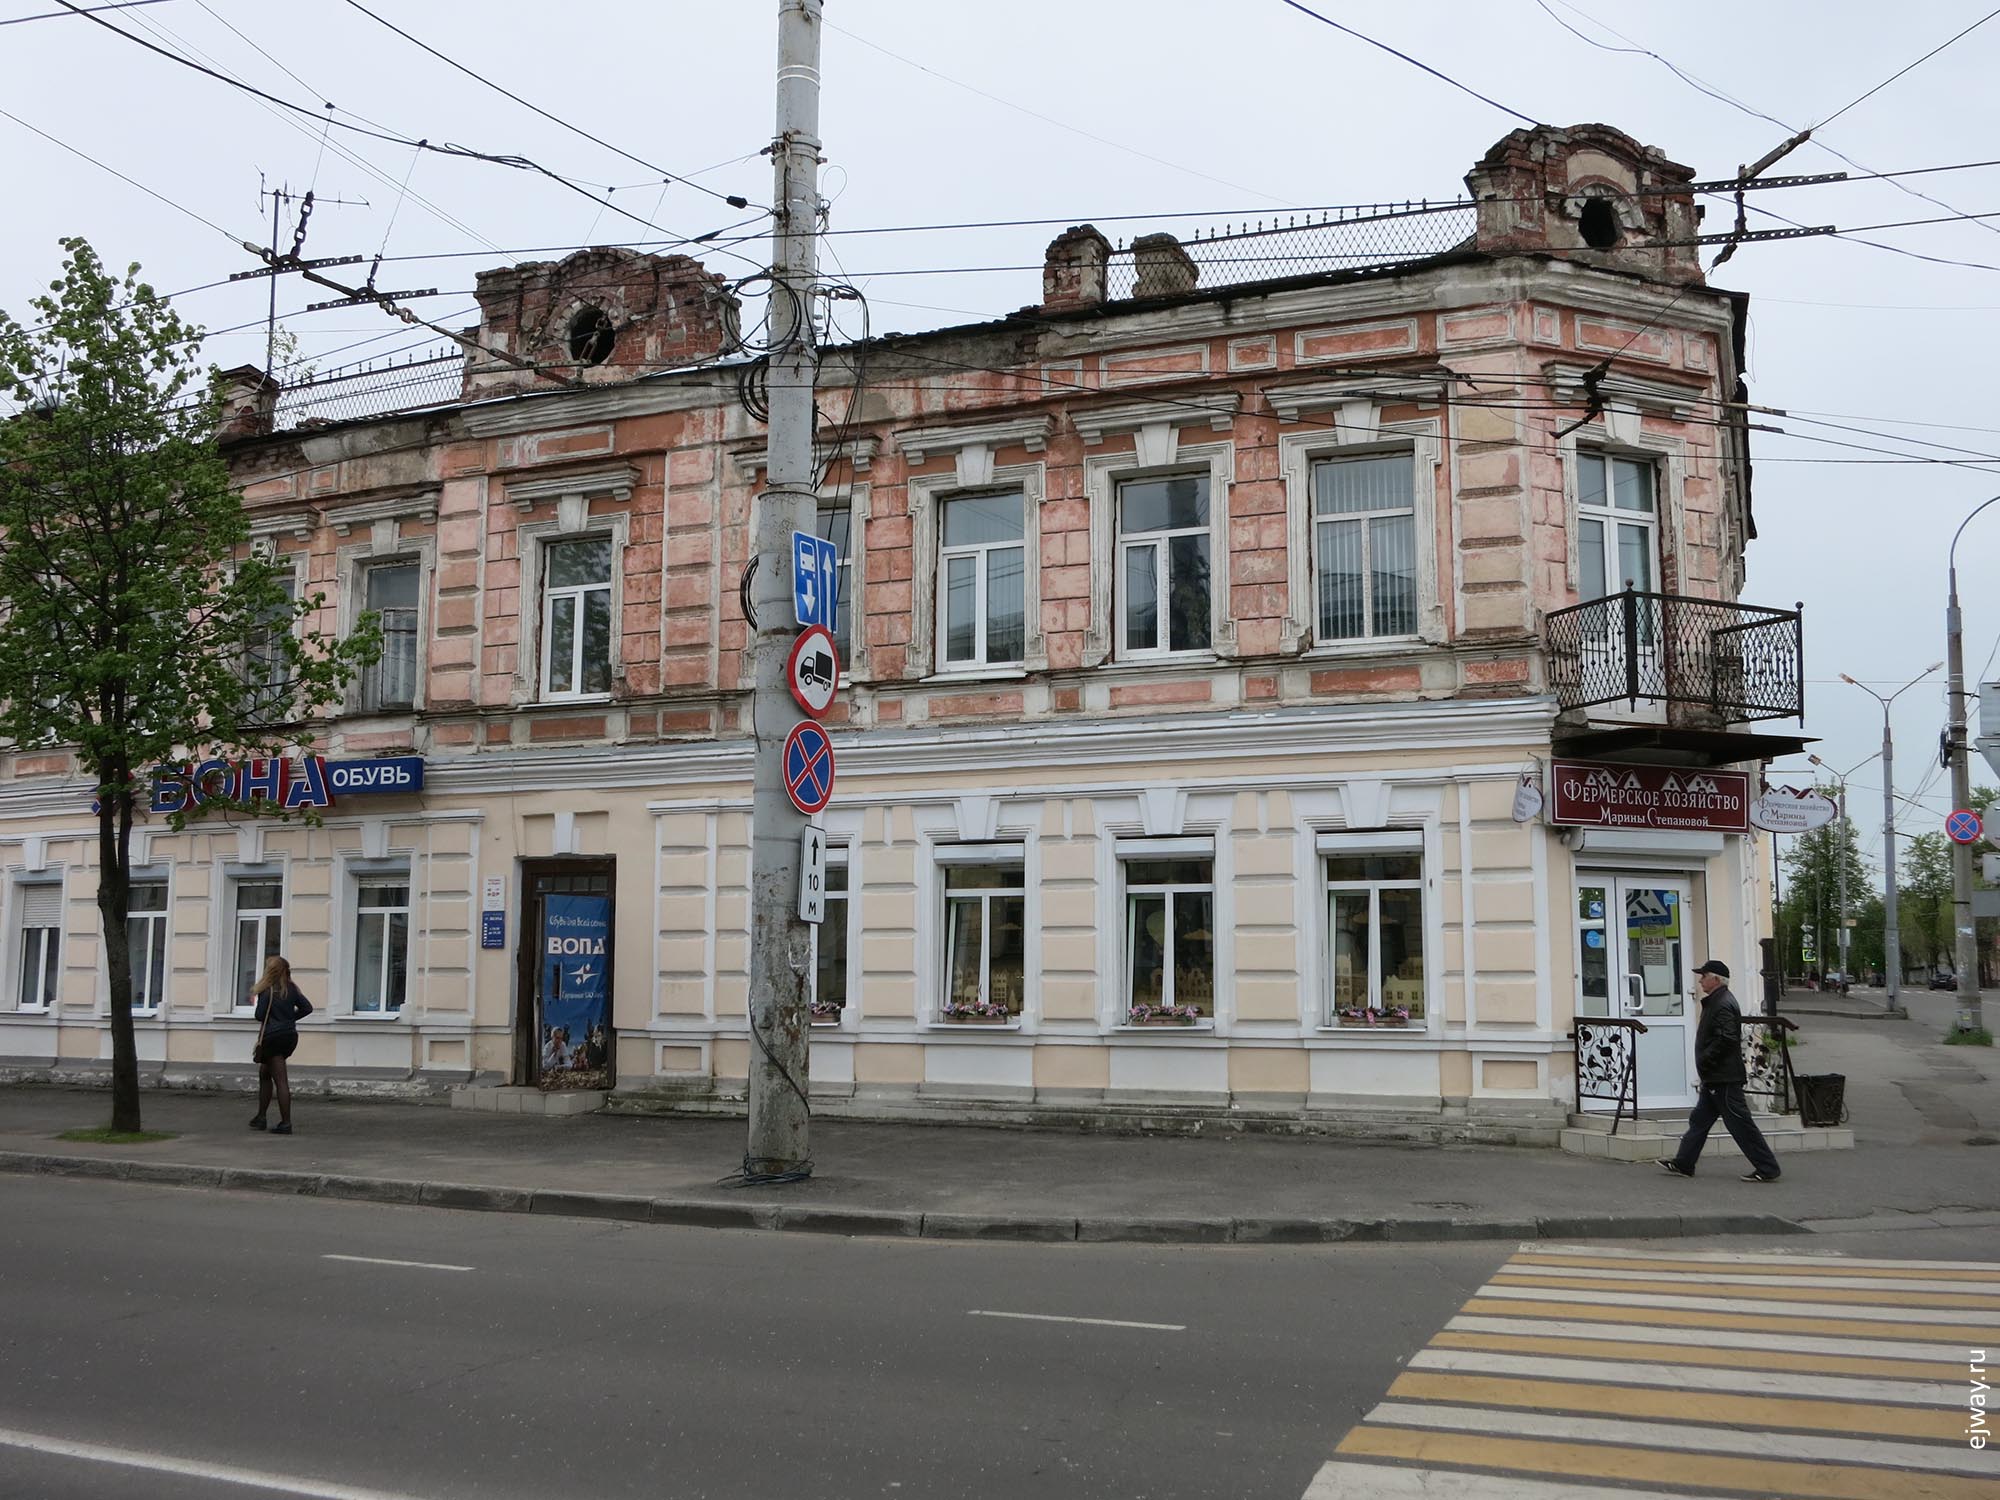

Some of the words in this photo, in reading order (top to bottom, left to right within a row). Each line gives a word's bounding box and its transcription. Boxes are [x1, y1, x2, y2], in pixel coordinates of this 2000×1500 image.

[151, 756, 333, 813] БОНА
[332, 766, 411, 787] ОБУВЬ
[1664, 791, 1740, 811] ХОЗЯЙСТВО
[1600, 806, 1646, 825] Марины
[1647, 807, 1709, 827] Степановой
[808, 873, 819, 891] 10
